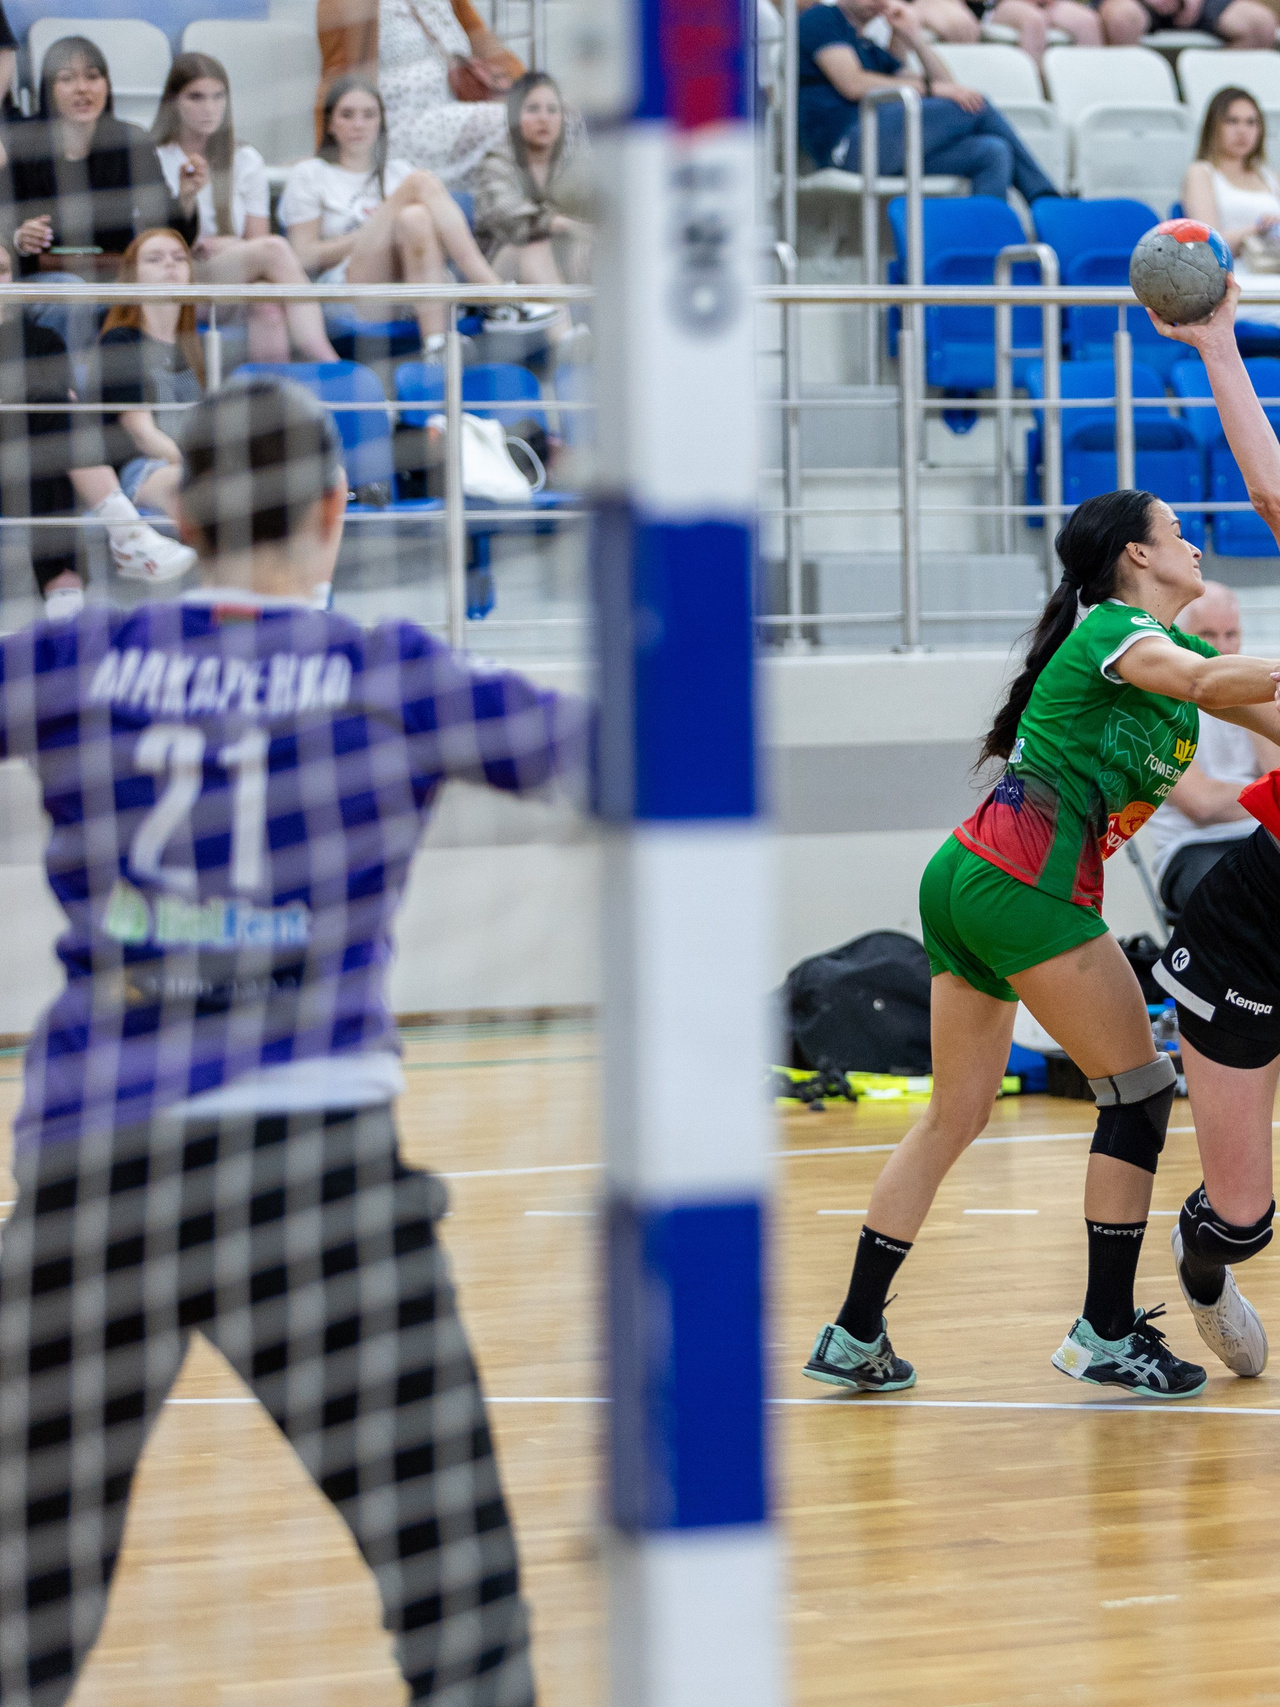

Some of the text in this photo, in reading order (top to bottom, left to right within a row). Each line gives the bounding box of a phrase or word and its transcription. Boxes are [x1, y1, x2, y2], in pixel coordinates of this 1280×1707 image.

[130, 725, 270, 893] 21
[1225, 988, 1273, 1015] Kempa
[1093, 1225, 1145, 1238] Kemp
